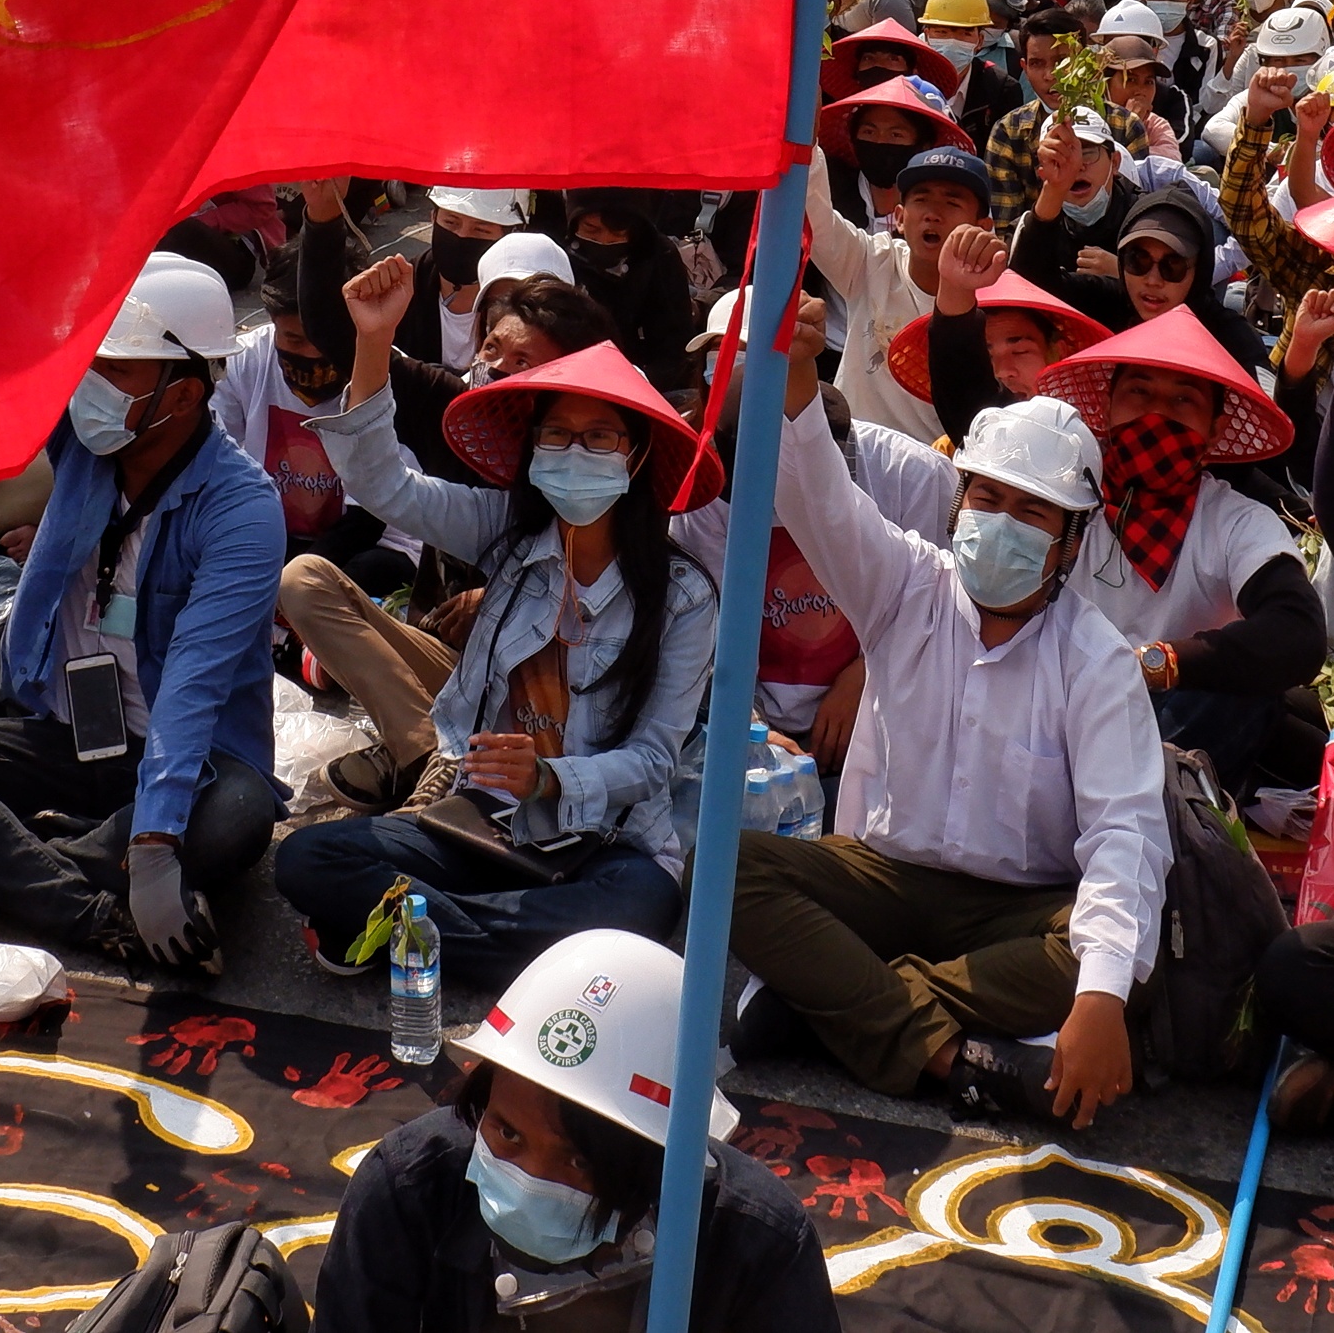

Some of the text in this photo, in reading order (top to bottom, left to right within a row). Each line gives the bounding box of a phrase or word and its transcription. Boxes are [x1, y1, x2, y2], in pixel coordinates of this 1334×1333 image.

[923, 153, 965, 168] Levi's
[1272, 865, 1303, 874] LEA
[579, 1015, 596, 1049] CROSS
[539, 1035, 583, 1066] SAFTY FIRST
